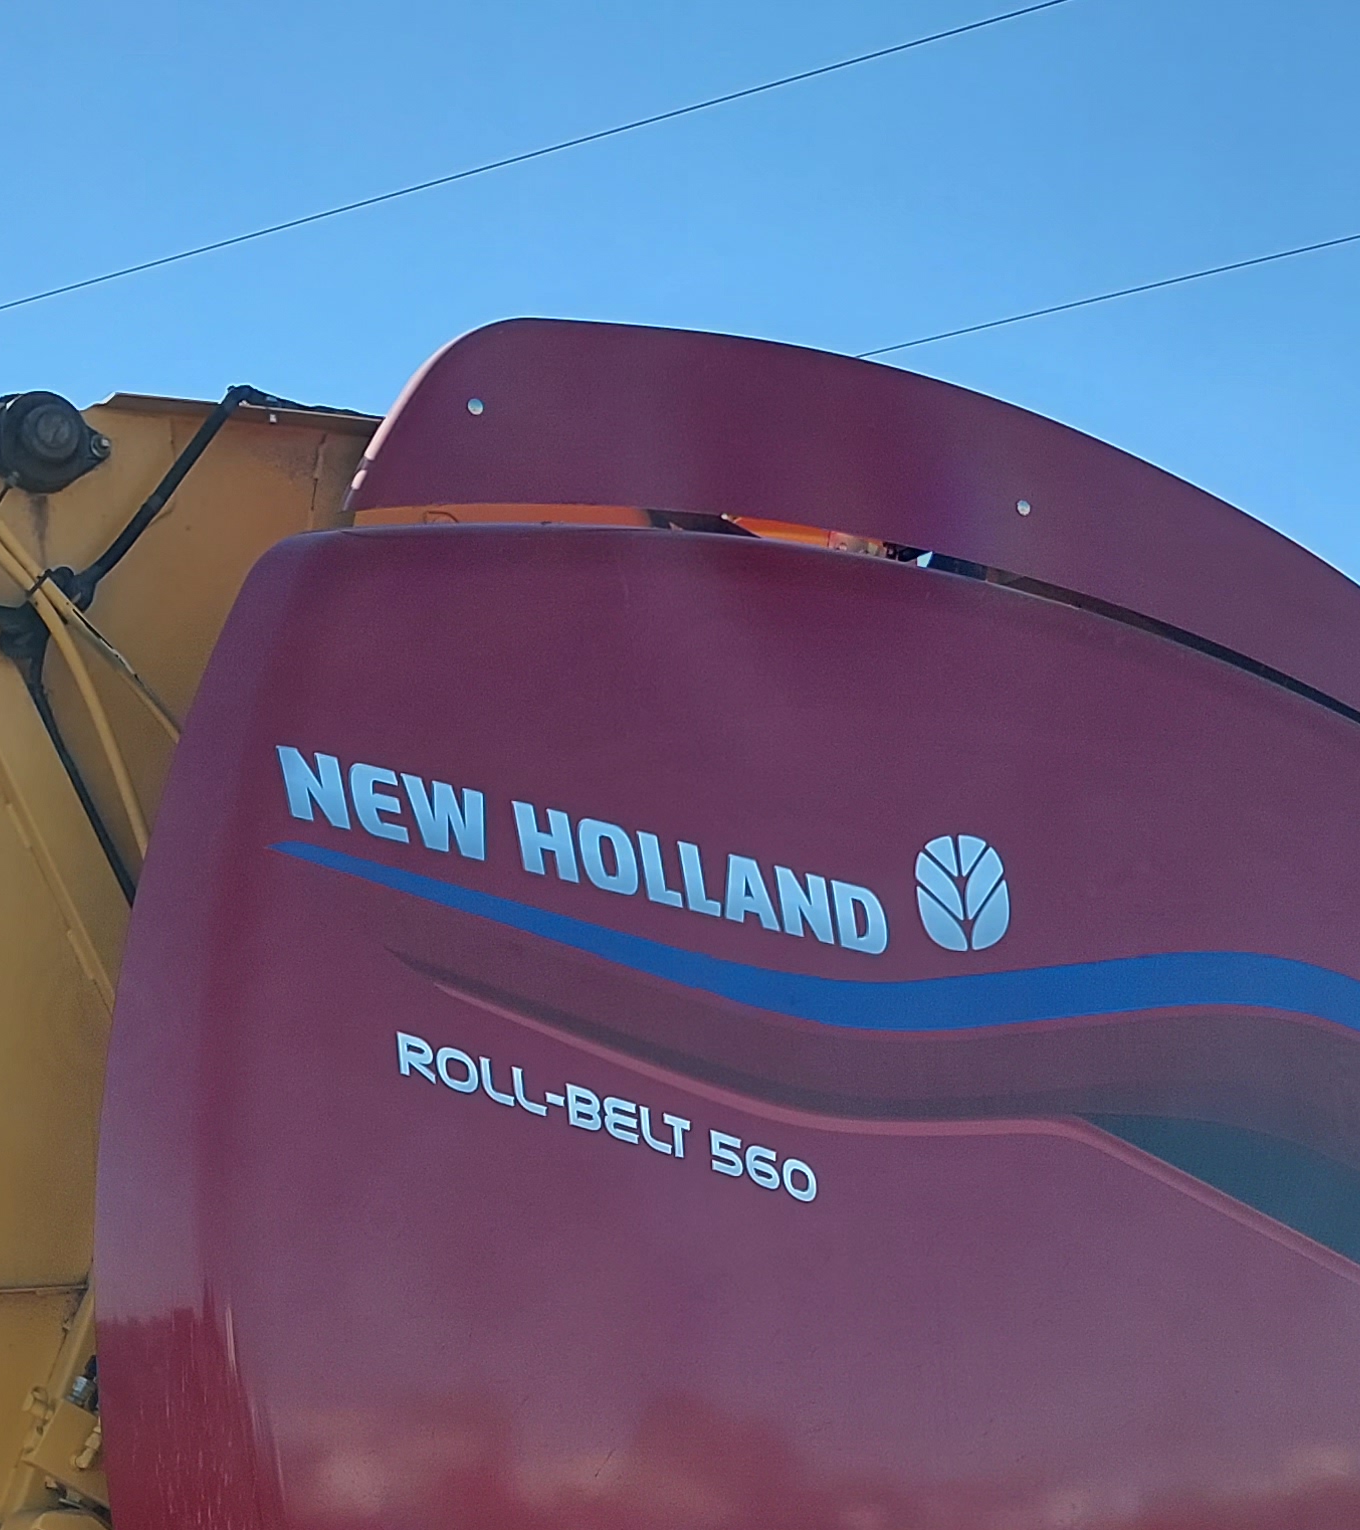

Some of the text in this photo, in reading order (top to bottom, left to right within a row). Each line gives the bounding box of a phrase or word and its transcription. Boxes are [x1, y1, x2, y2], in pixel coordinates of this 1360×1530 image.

[276, 745, 888, 955] NEW HOLLAND
[396, 1031, 818, 1202] ROLL-BELT 560
